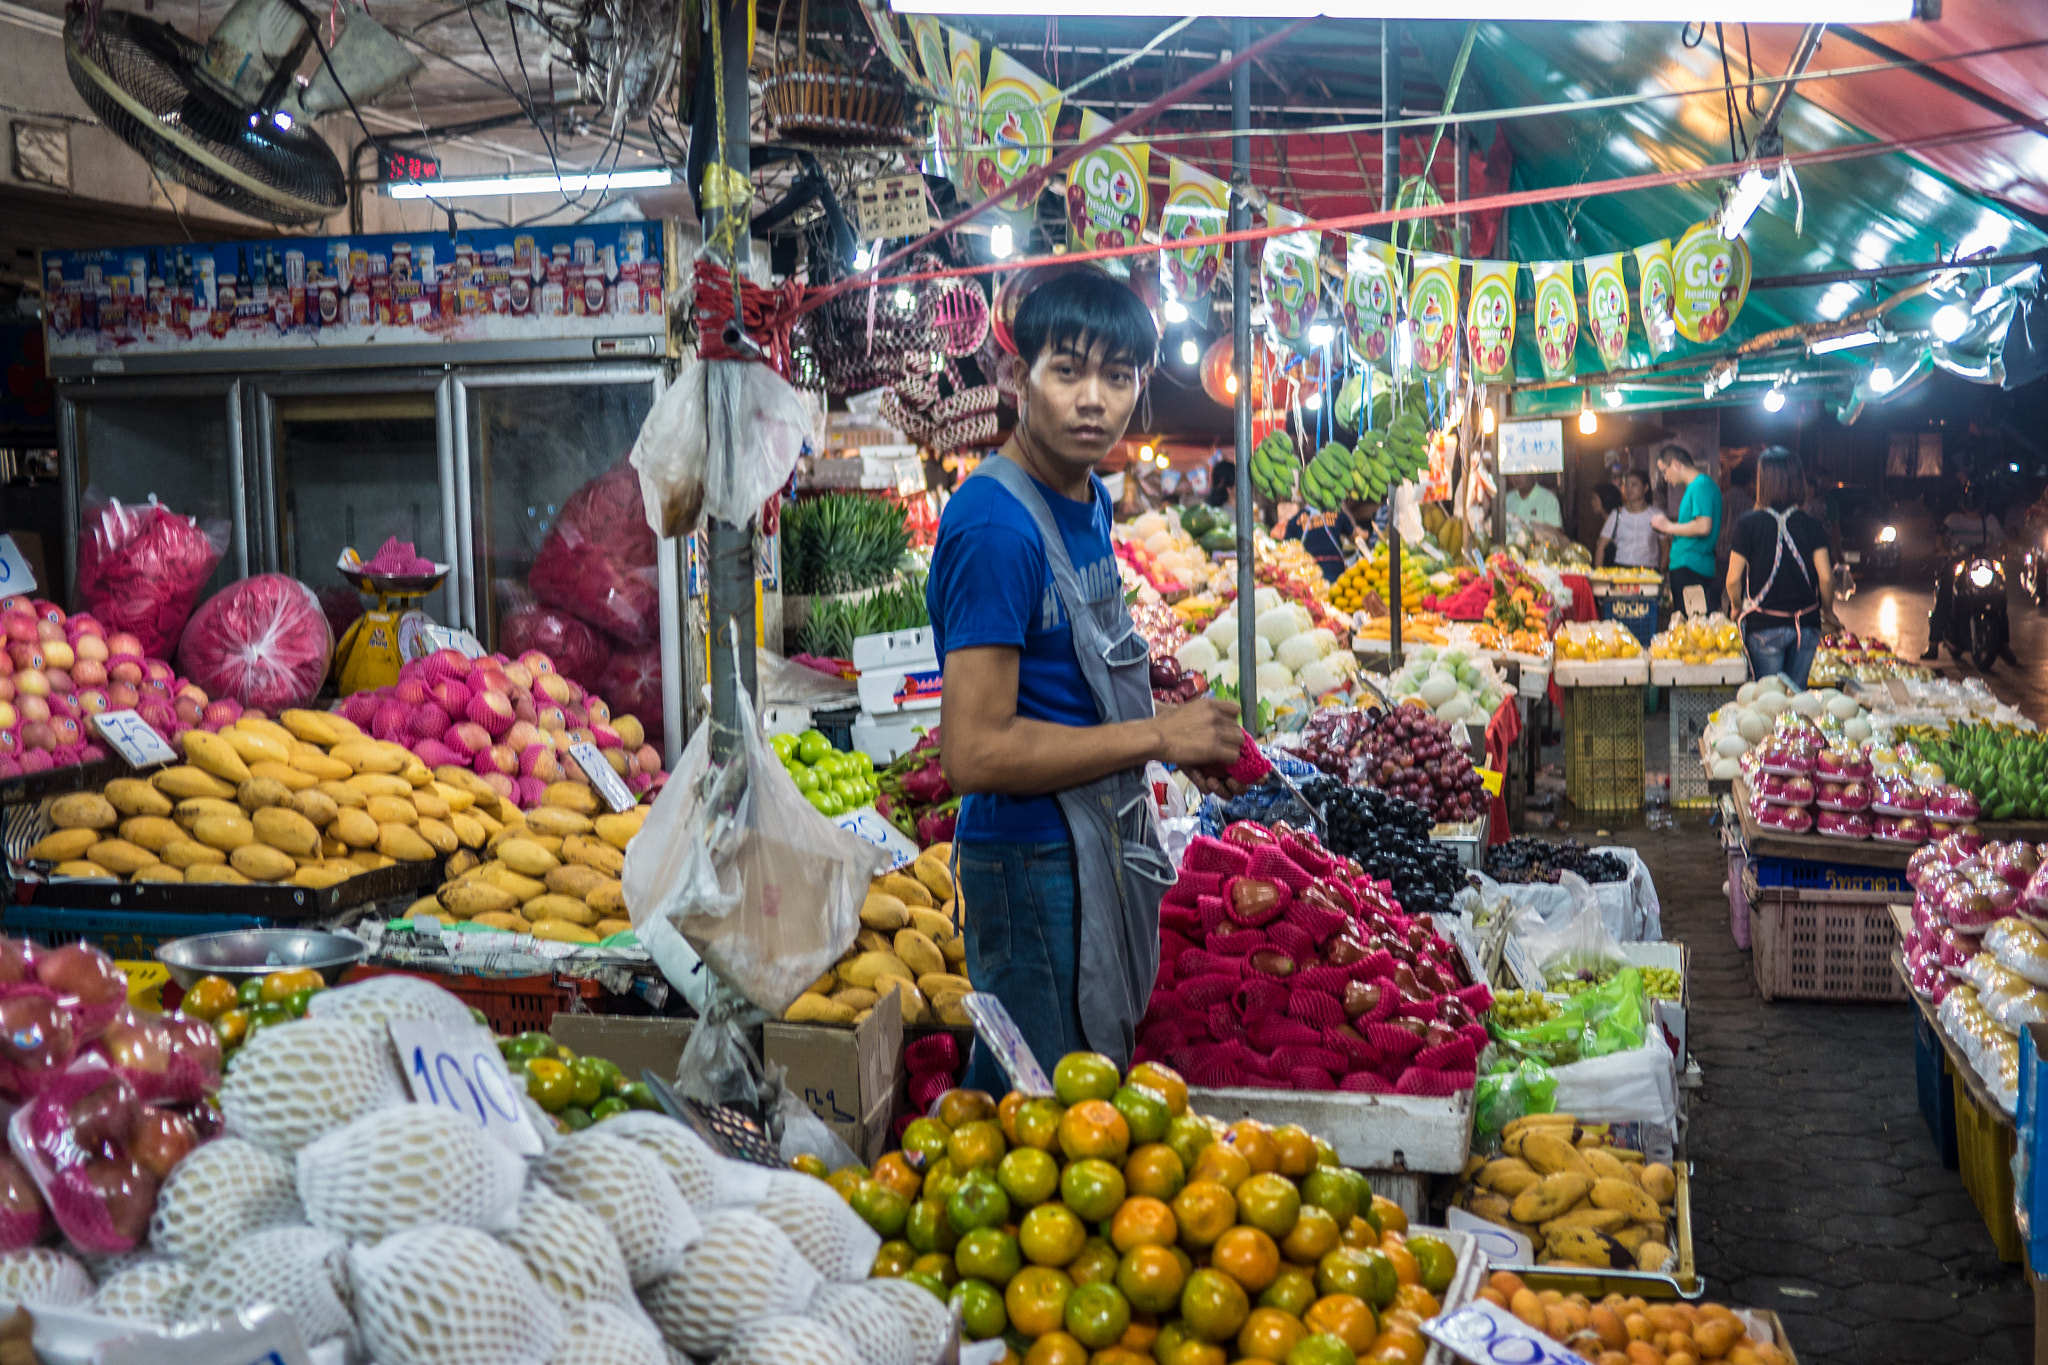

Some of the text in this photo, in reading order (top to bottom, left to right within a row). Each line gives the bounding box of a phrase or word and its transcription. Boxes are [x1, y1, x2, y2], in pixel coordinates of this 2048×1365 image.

[1085, 155, 1136, 210] GO
[1086, 193, 1122, 226] healthy
[1684, 252, 1734, 288] GO
[1353, 271, 1388, 313] GO
[1595, 284, 1621, 319] GO
[1684, 288, 1719, 302] healthy
[1476, 294, 1508, 330] GO
[414, 1045, 518, 1129] 100
